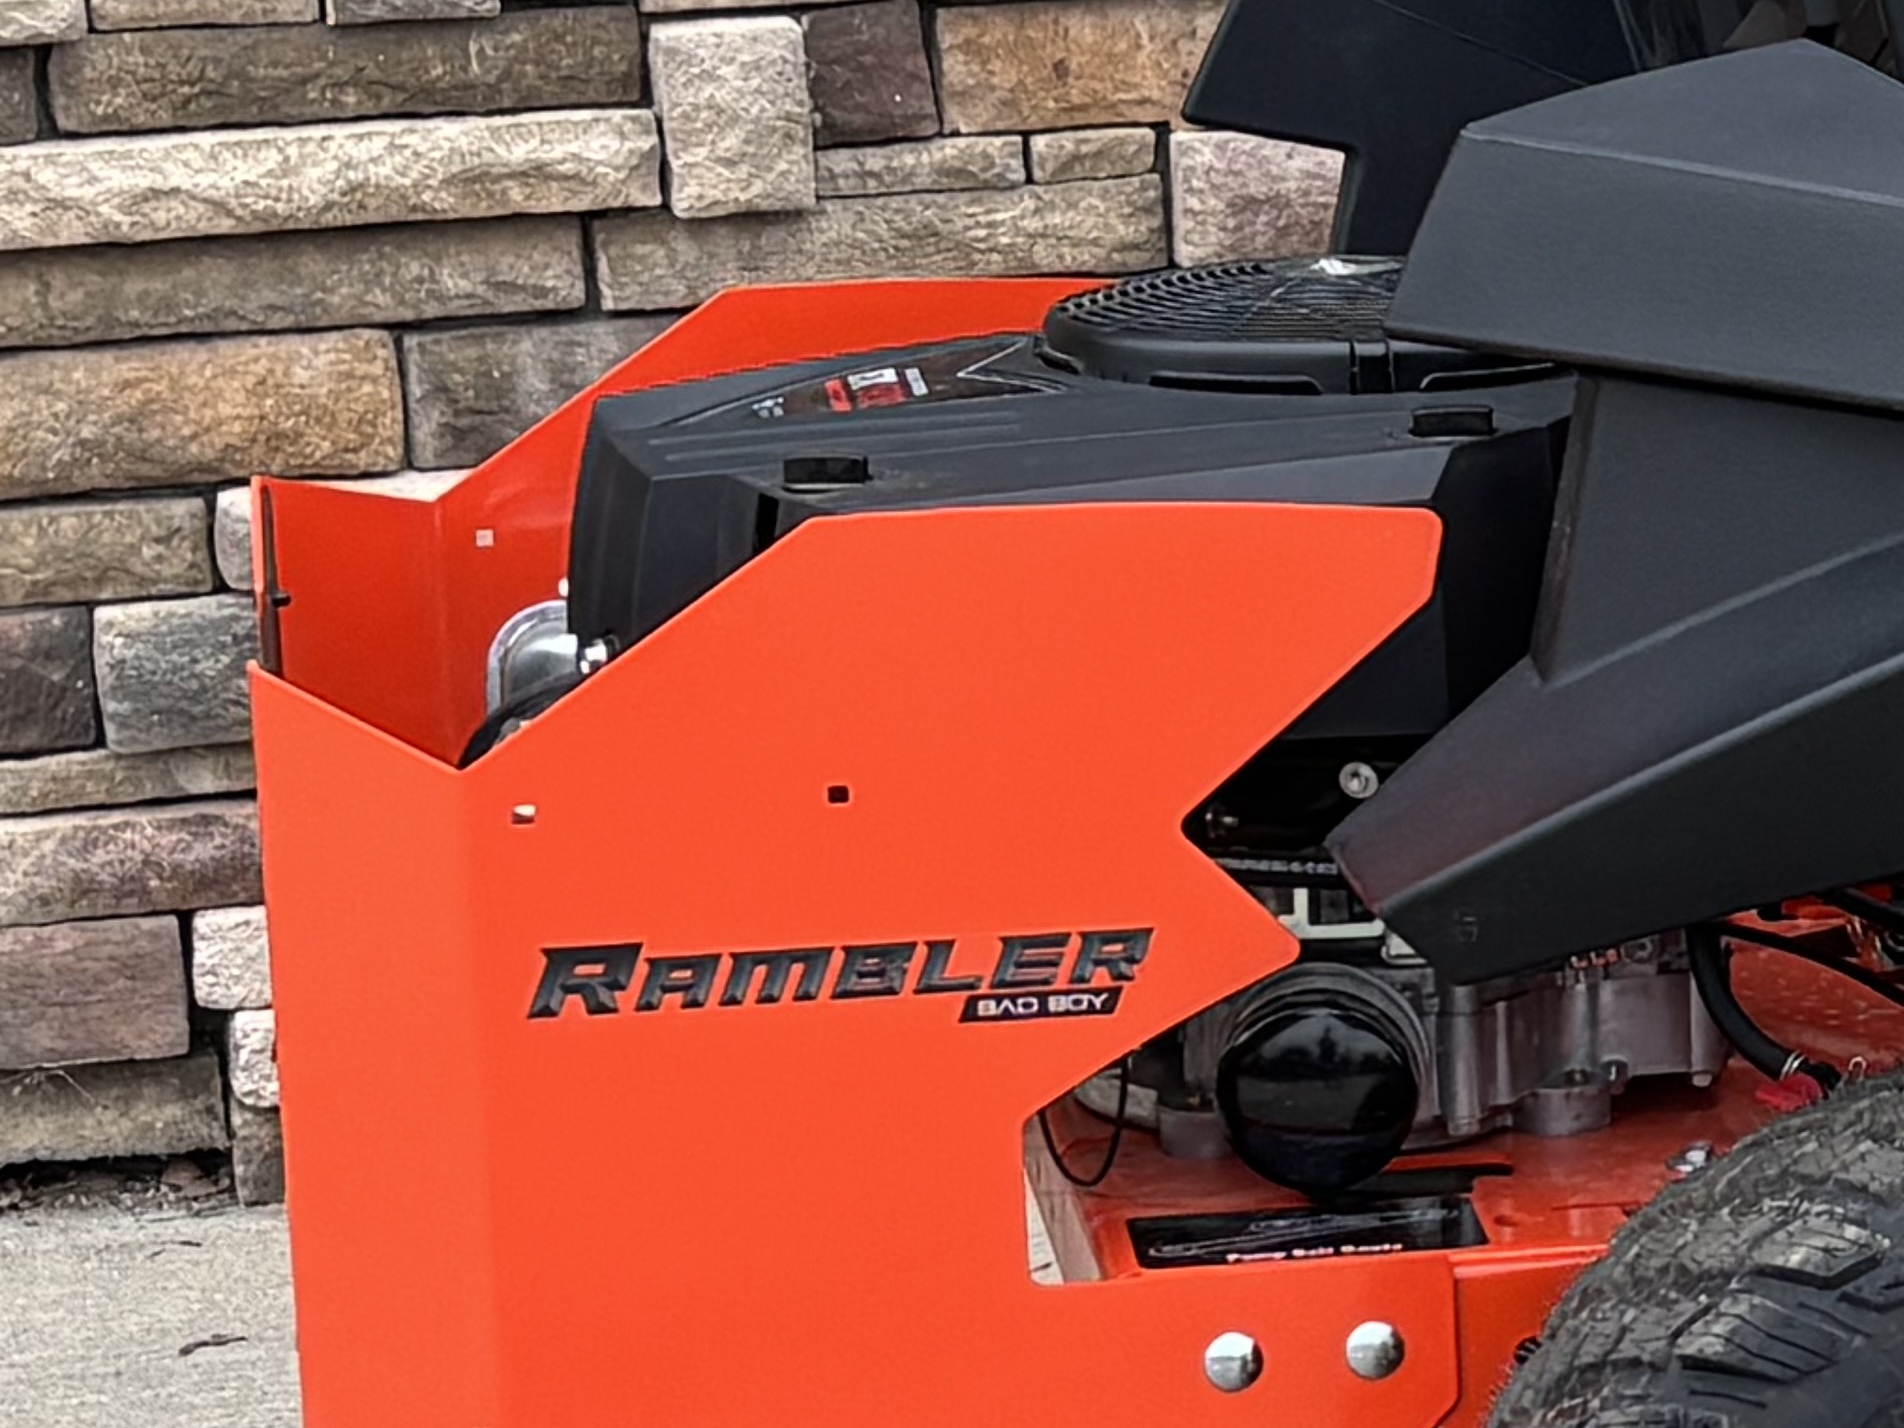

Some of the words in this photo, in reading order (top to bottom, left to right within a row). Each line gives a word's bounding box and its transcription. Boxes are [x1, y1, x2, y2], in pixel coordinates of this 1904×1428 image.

[526, 927, 1155, 1020] RAMBLER
[977, 996, 1039, 1018] BAD
[1048, 992, 1109, 1012] BOY
